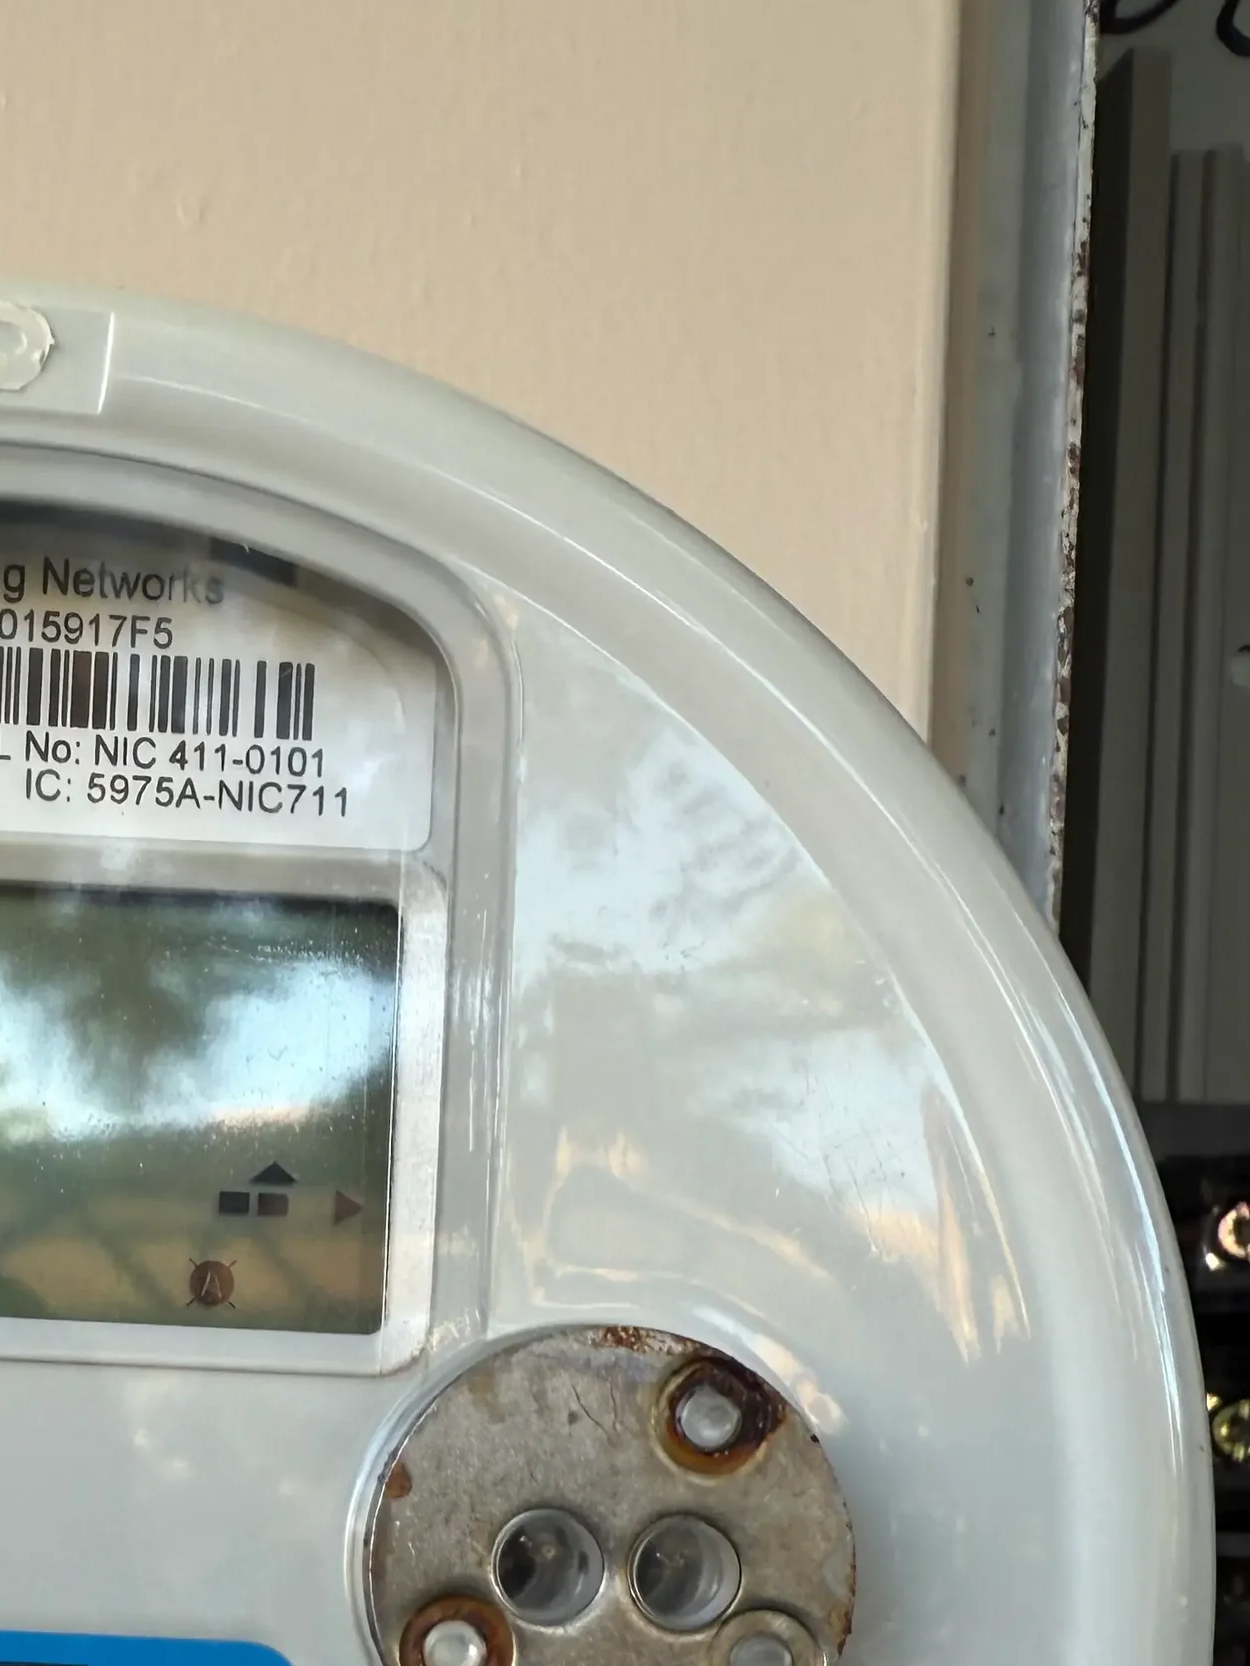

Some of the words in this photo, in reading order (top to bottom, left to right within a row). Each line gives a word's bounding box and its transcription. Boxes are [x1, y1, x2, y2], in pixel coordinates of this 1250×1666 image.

[40, 557, 227, 605] Networks
[24, 736, 84, 768] No:
[93, 737, 158, 770] NIC
[168, 742, 327, 778] 411-0101
[23, 772, 73, 804] IC:
[85, 772, 351, 818] 5975A-NIC711
